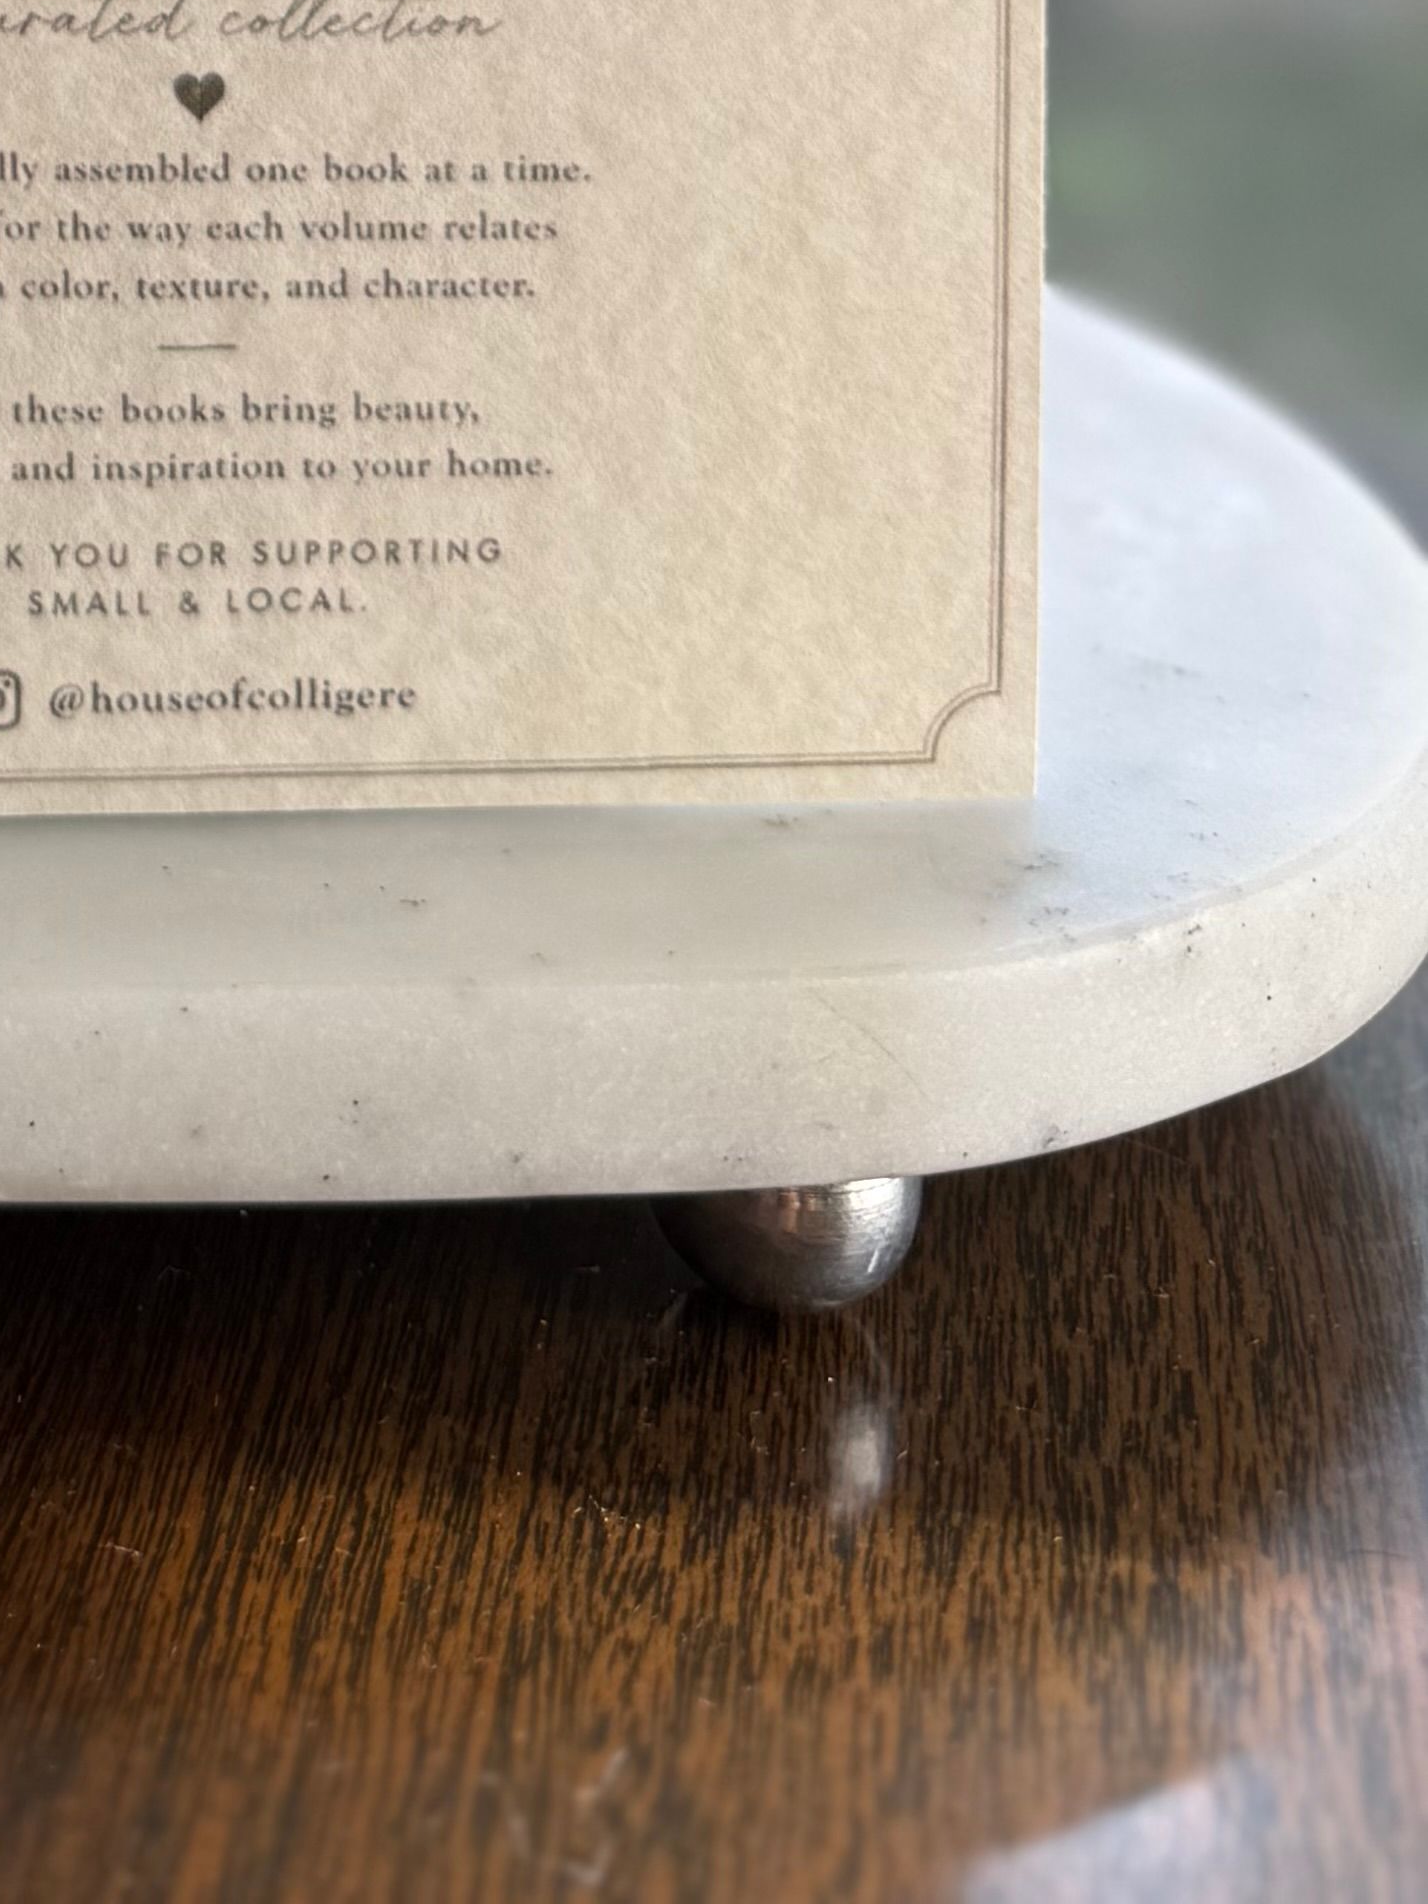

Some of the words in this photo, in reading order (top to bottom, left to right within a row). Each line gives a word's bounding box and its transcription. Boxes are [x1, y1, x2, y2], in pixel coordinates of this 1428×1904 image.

[54, 151, 231, 185] assembled
[245, 163, 308, 185] one
[323, 151, 409, 184] book
[425, 160, 457, 185] at
[470, 164, 489, 184] a
[504, 155, 591, 184] time.
[57, 210, 111, 243] the
[126, 221, 192, 249] way
[205, 210, 284, 243] each
[300, 210, 429, 242] volume
[444, 210, 558, 243] relates
[20, 268, 119, 304] color,
[136, 277, 270, 303] texture,
[286, 267, 350, 300] and
[363, 267, 535, 300] character.
[12, 393, 104, 427] these
[121, 393, 226, 425] books
[242, 392, 337, 431] bring
[353, 390, 480, 429] beauty,
[12, 451, 75, 483] and
[93, 452, 286, 490] inspiration
[302, 458, 337, 481] to
[352, 459, 432, 486] your
[447, 447, 552, 479] home.
[49, 542, 129, 571] YOU
[155, 540, 227, 571] FOR
[251, 537, 502, 569] SUPPORTING
[28, 590, 151, 620] SMALL
[178, 590, 201, 618] &
[226, 587, 366, 619] LOCAL.
[49, 676, 416, 721] @houseofcolligere
